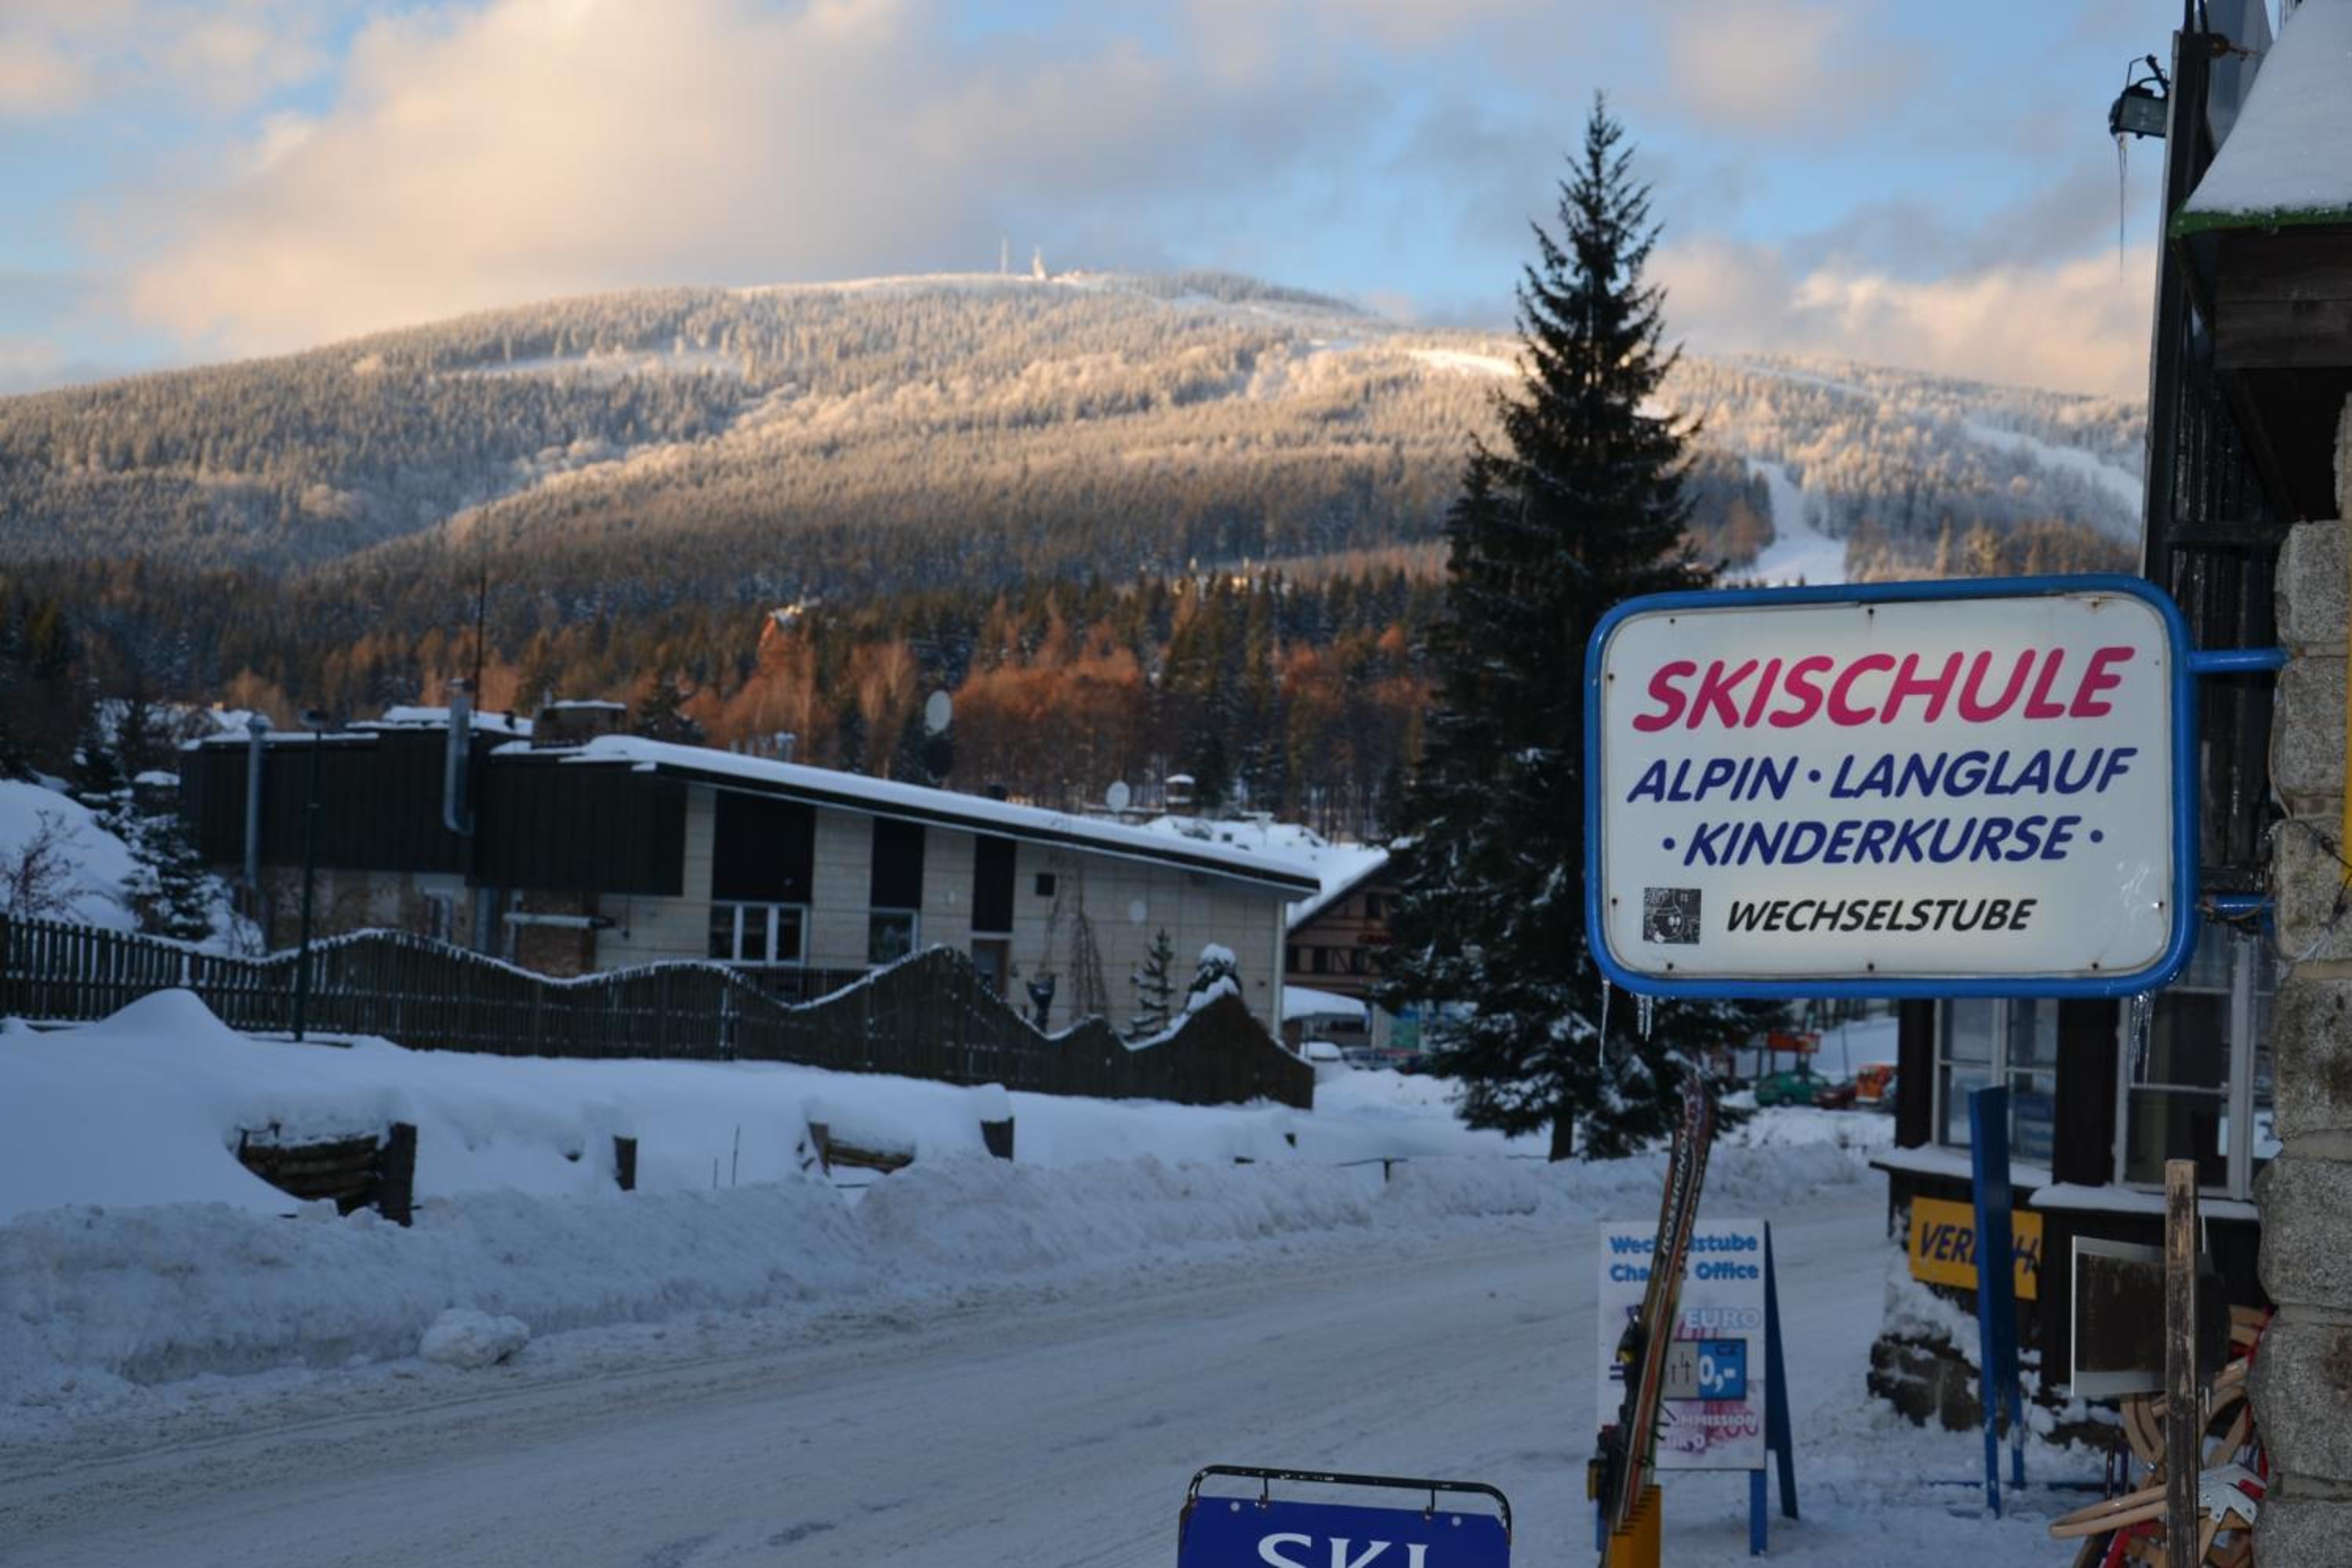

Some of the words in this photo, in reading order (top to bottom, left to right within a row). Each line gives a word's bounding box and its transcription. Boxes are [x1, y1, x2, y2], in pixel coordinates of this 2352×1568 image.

[1633, 646, 2135, 731] SKISCHULE
[1627, 756, 1798, 803] ALPIN
[1830, 747, 2138, 798] LANGLAUF
[1683, 815, 2082, 866] KINDERKURSE
[1727, 898, 2038, 932] WECHSELSTUBE
[1610, 1233, 1758, 1254] Weclstube
[1920, 1221, 2038, 1274] VERH
[1695, 1261, 1759, 1280] Office
[1685, 1307, 1761, 1330] EURO
